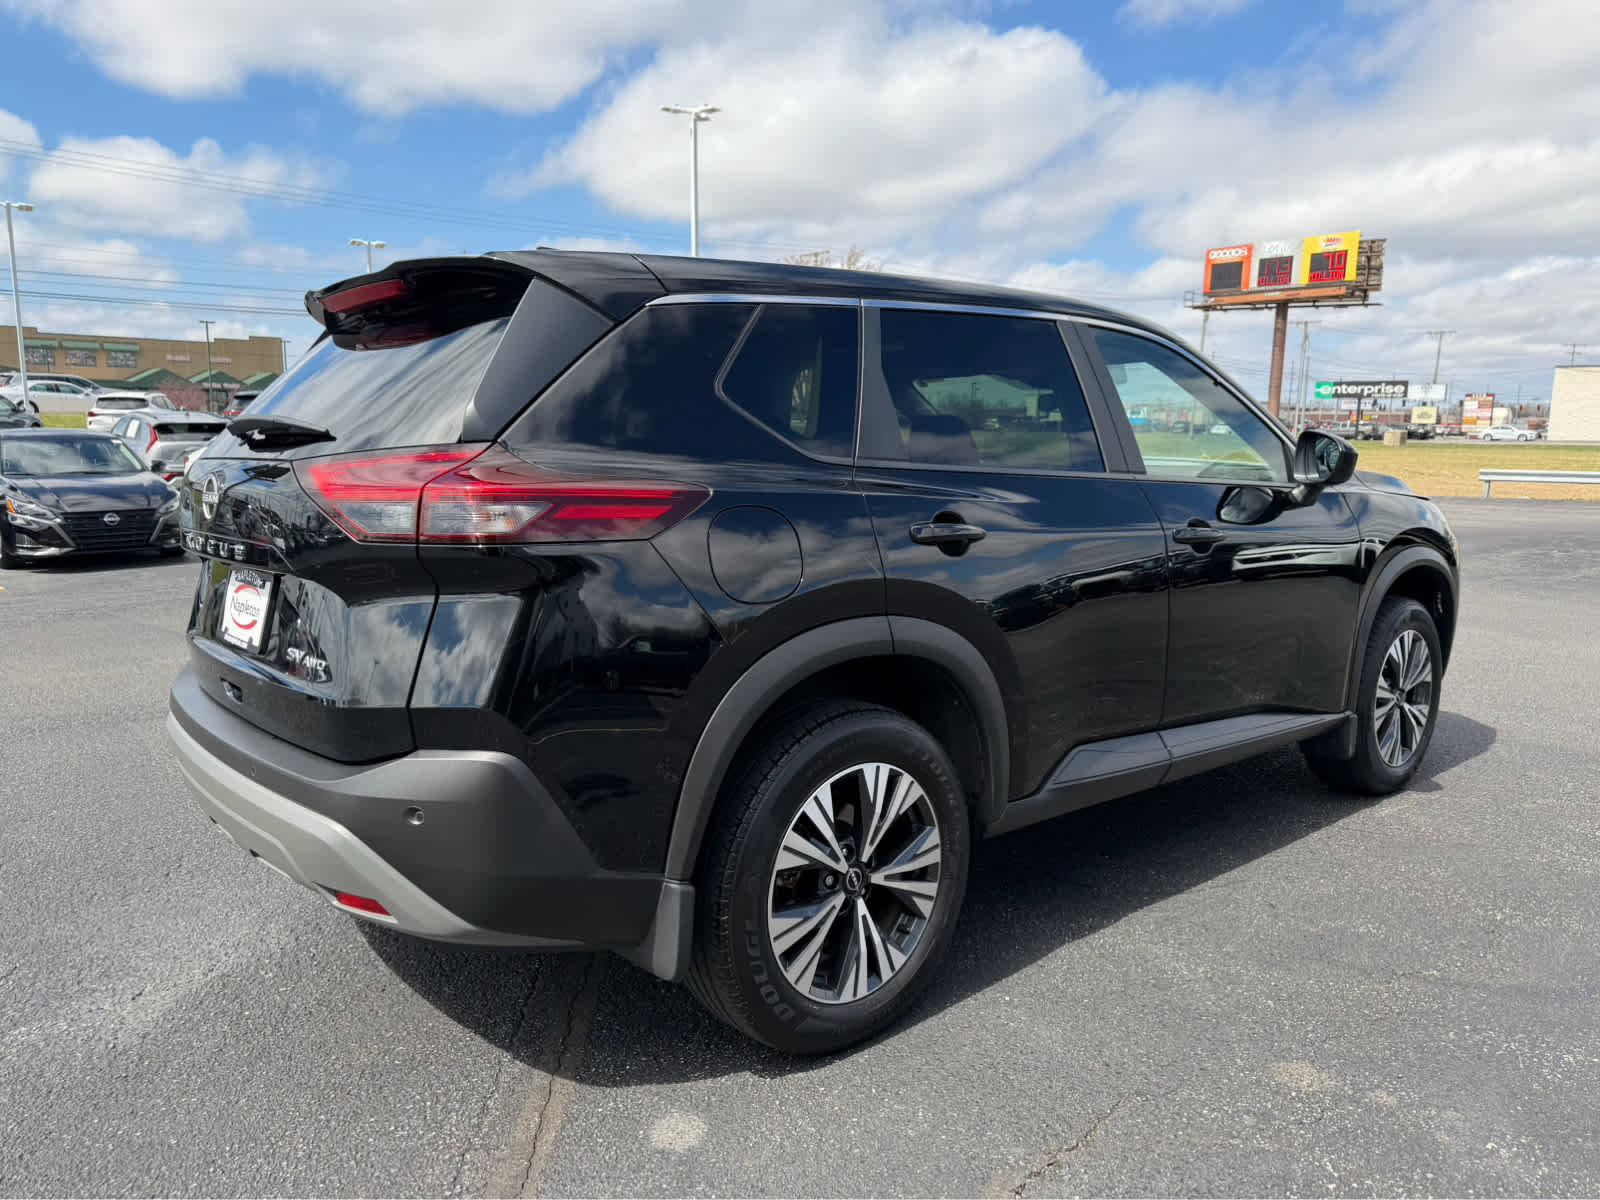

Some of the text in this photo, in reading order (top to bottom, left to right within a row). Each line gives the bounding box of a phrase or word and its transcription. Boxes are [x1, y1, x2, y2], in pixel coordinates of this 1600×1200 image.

[1323, 250, 1346, 270] 70
[1309, 269, 1345, 282] MILLION
[1319, 382, 1405, 397] enterprise
